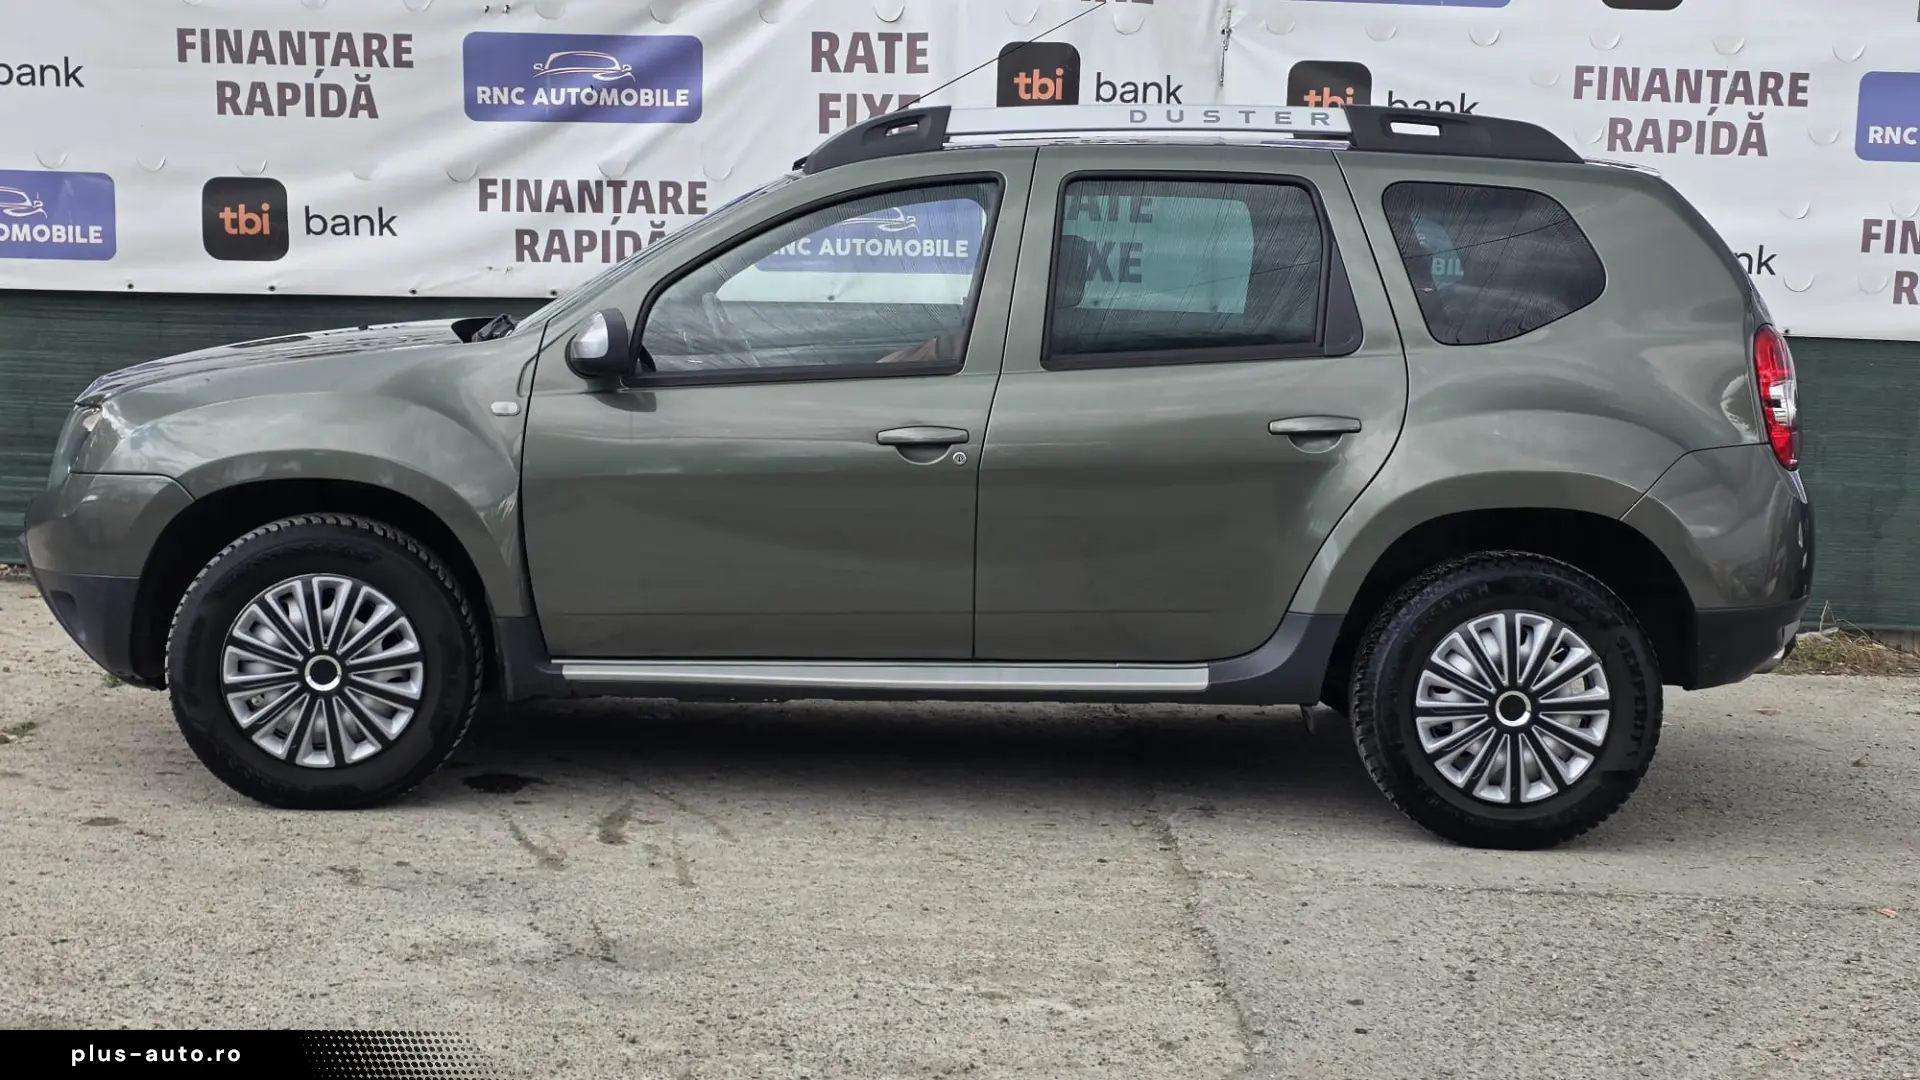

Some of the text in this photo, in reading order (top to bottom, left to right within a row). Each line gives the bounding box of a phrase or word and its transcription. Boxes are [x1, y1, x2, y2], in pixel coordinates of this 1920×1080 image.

[177, 28, 414, 79] FINANȚARE
[811, 31, 929, 74] RATE
[476, 86, 690, 107] RNC AUTOMOBILE
[1014, 68, 1183, 105] tbi bank
[1573, 65, 1810, 116] FINANȚARE
[1129, 109, 1331, 126] DUSTER
[1868, 125, 1918, 145] RNC
[478, 178, 708, 225] FINANȚARE
[219, 203, 398, 237] tbi bank
[818, 238, 969, 258] AUTOMOBILE
